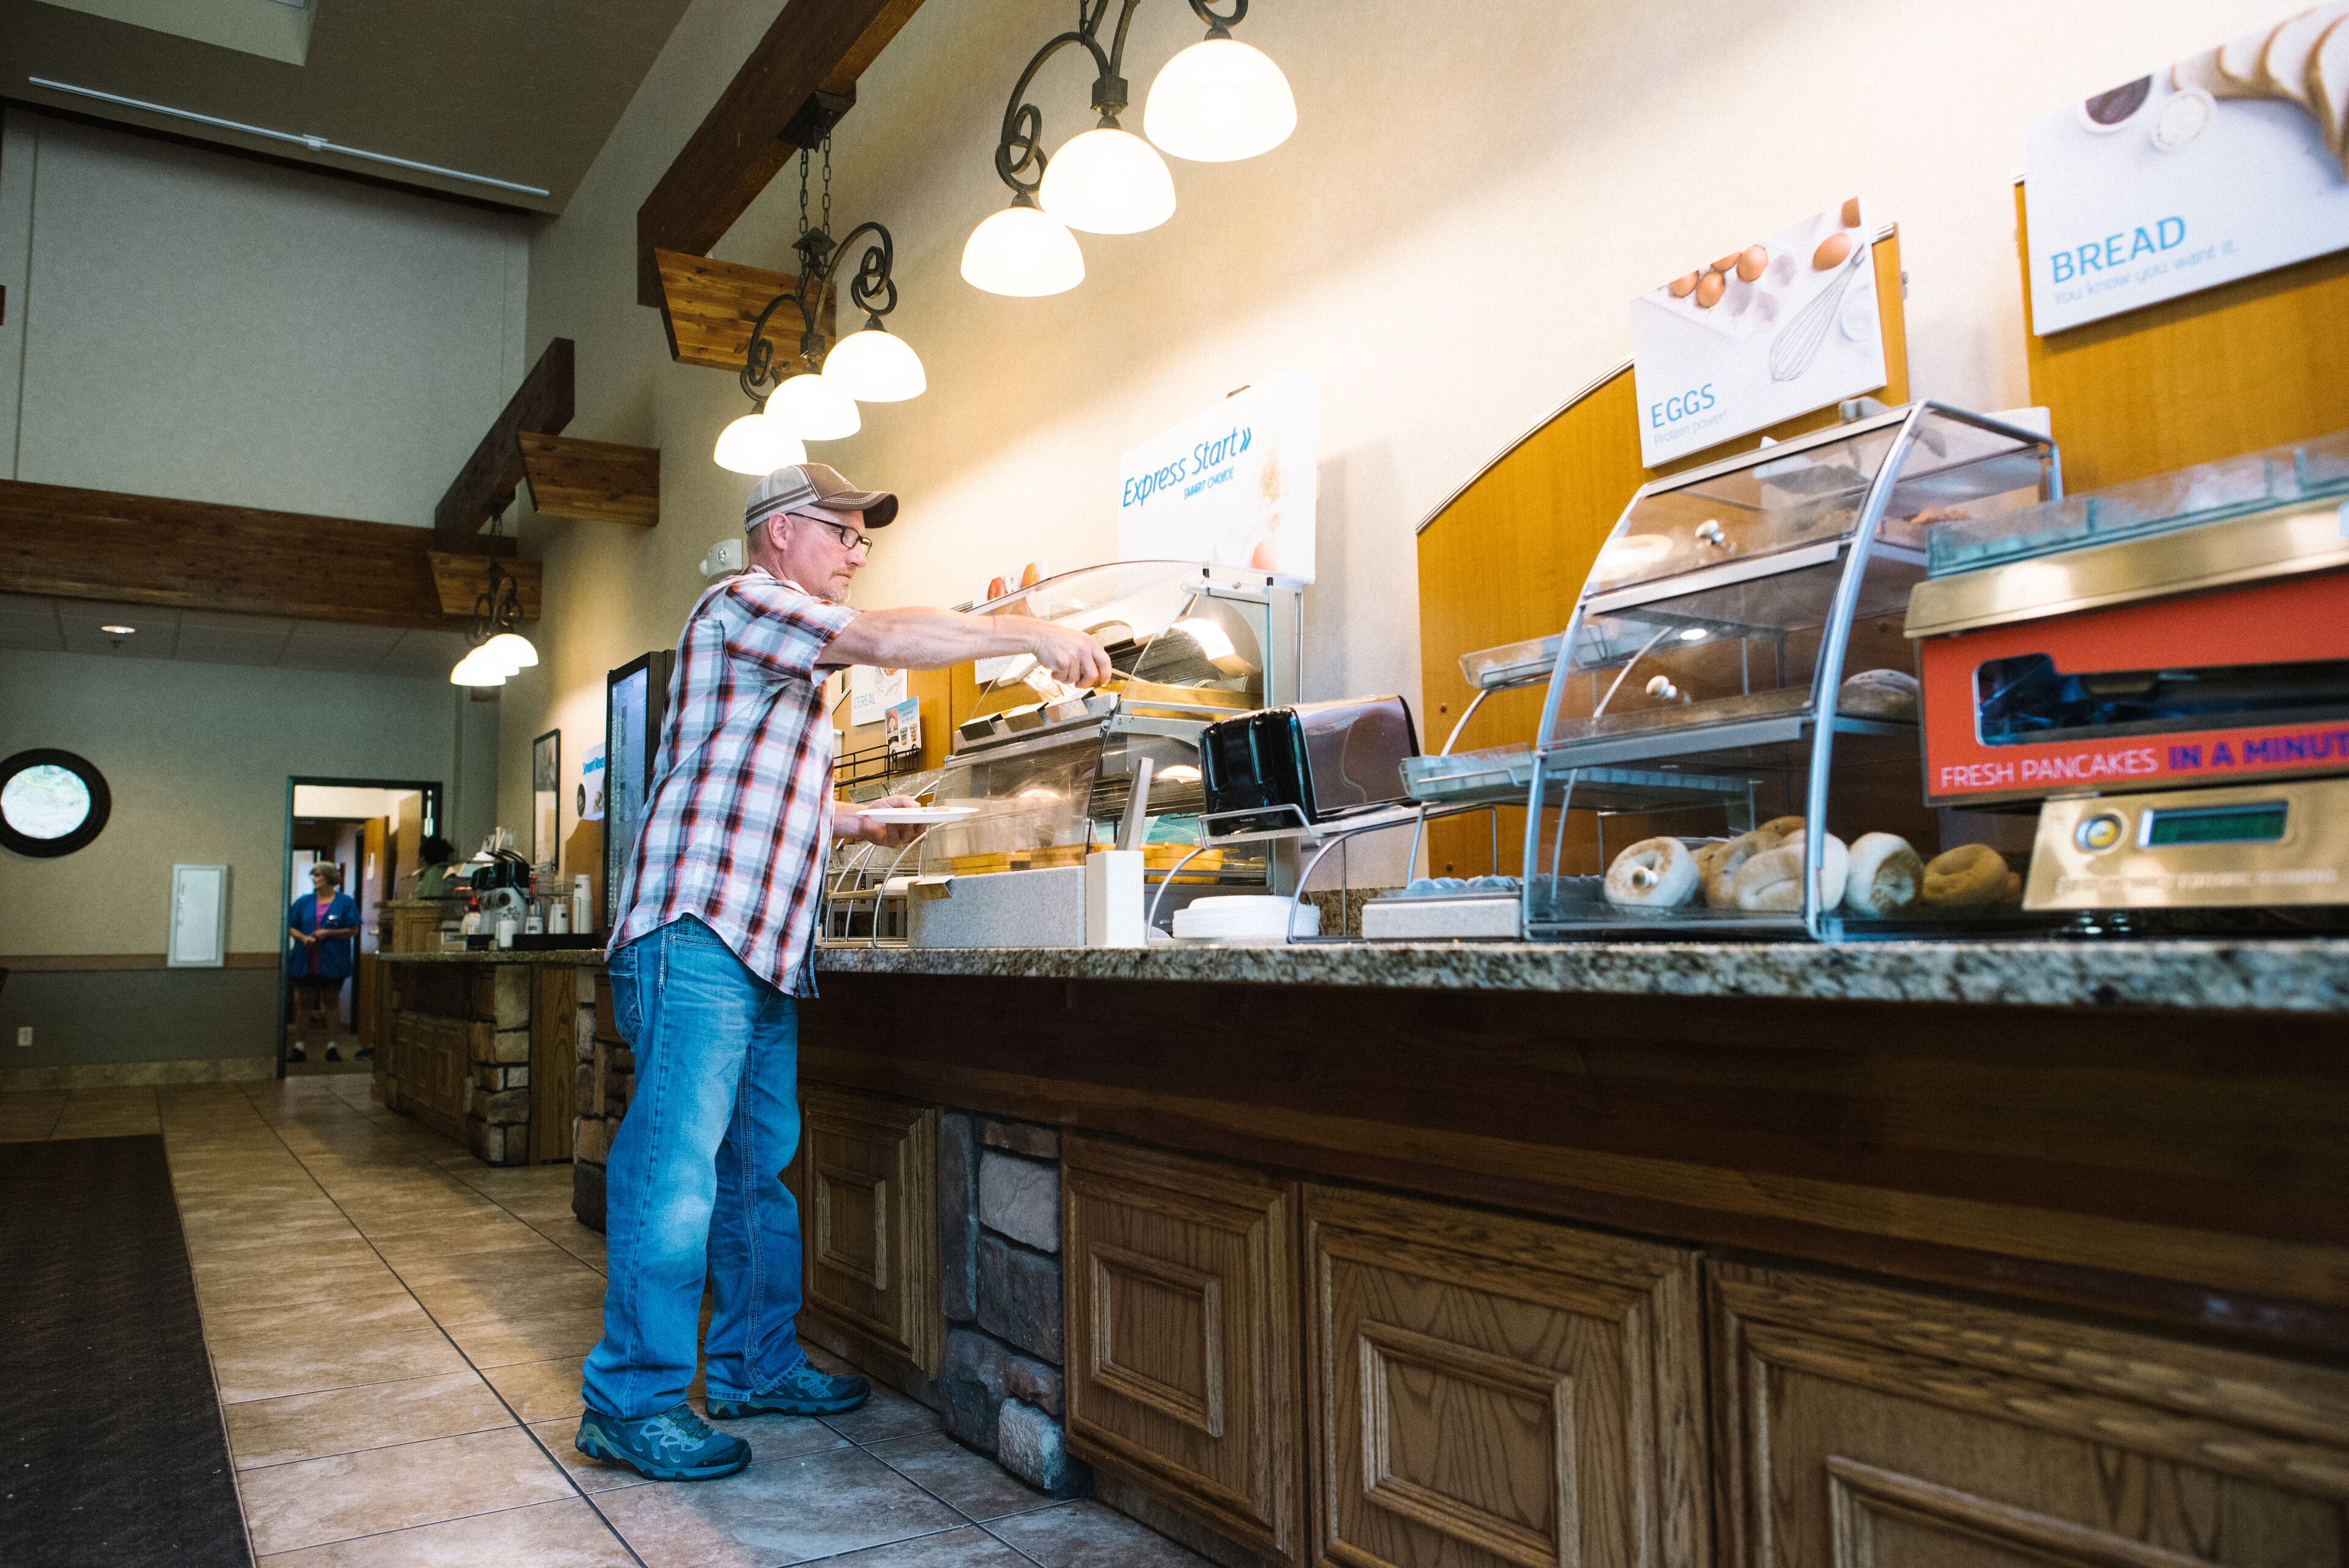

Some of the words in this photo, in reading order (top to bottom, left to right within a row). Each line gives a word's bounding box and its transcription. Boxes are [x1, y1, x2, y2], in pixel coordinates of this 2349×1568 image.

[2050, 215, 2186, 284] BREAD
[2085, 274, 2130, 295] know
[2134, 262, 2169, 285] you
[1650, 382, 1716, 429] EGGS
[1122, 457, 1187, 508] Express
[1190, 426, 1239, 475] Start
[1183, 479, 1206, 500] SMART
[1207, 466, 1235, 489] CHOICE
[853, 692, 876, 709] CEREAL
[1940, 762, 2015, 788] FRESH
[2021, 747, 2159, 781] PANCAKES
[2168, 745, 2201, 770] IN
[2211, 741, 2236, 767] A
